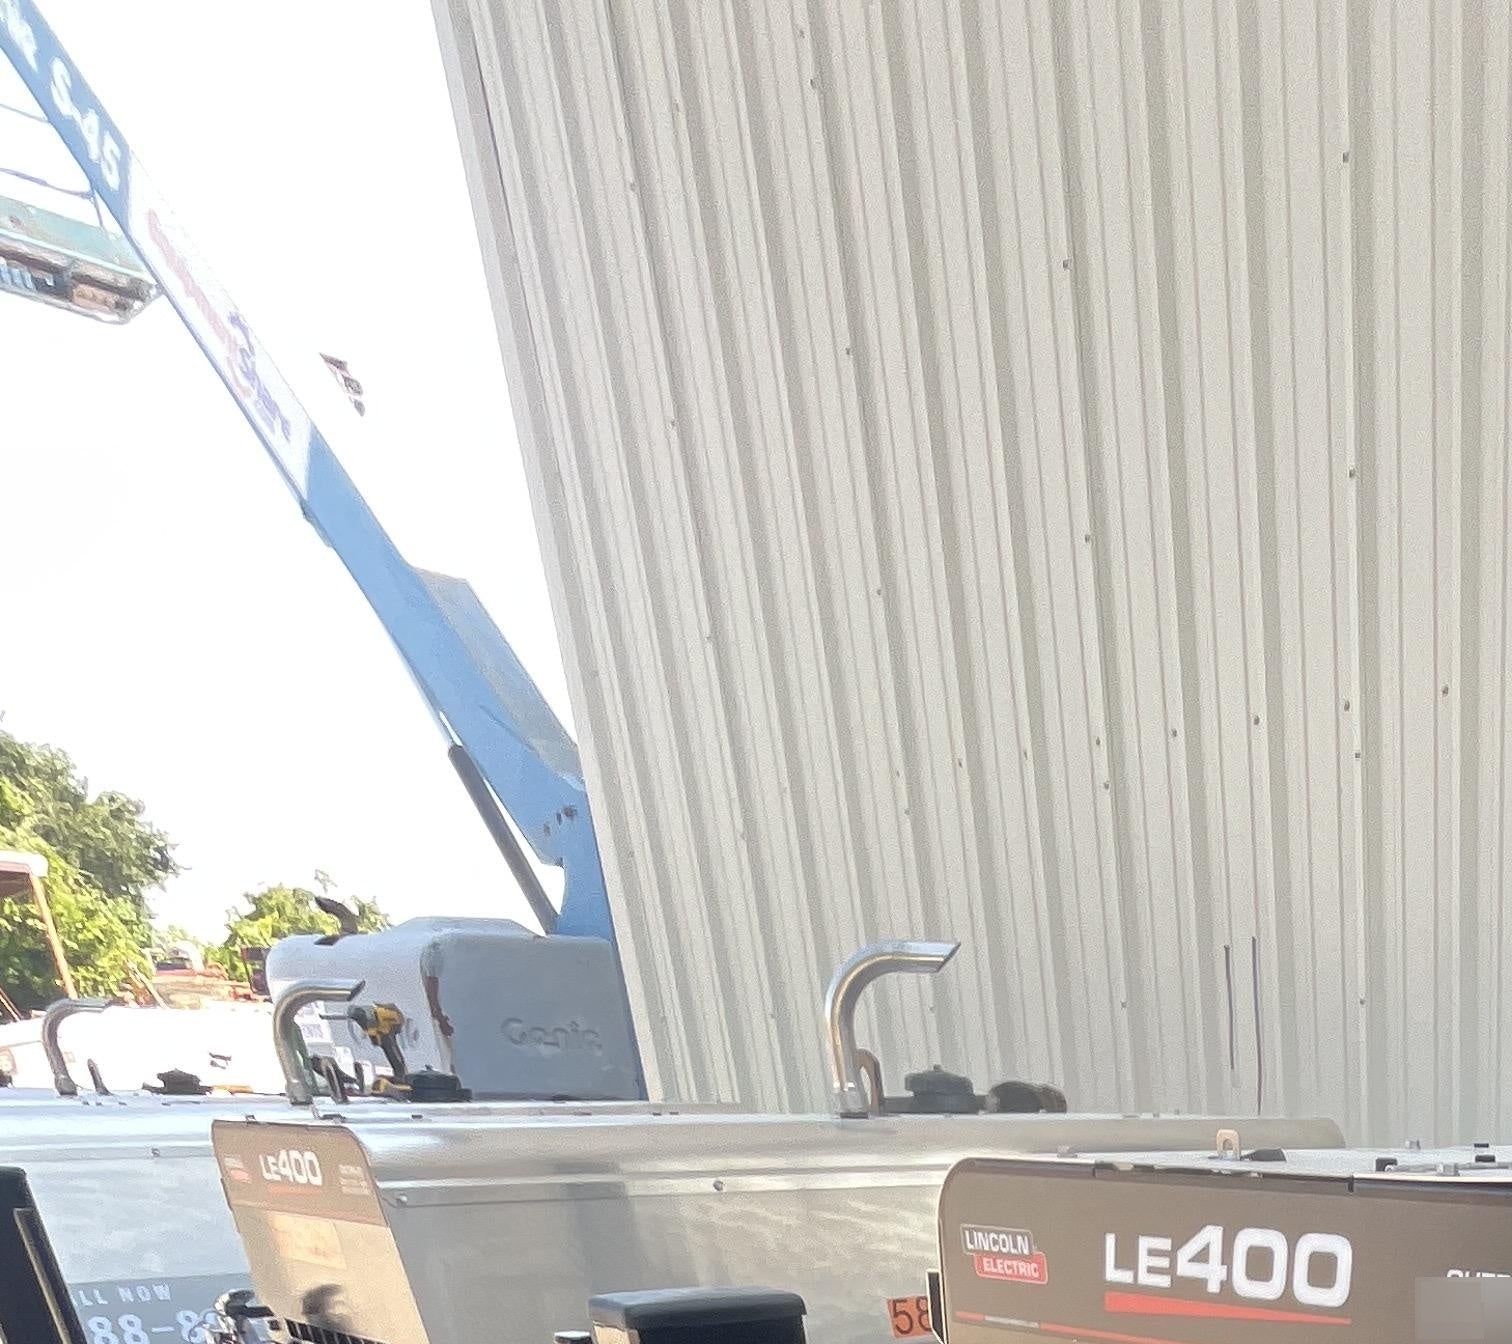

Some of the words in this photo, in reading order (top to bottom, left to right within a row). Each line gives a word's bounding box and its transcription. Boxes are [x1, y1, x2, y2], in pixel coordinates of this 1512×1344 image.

[259, 1150, 323, 1187] LE400
[964, 1230, 1030, 1255] LINCOLN
[982, 1257, 1040, 1278] ELECTRIC
[1105, 1225, 1352, 1307] LE400
[70, 1289, 109, 1306] LL
[117, 1281, 171, 1303] NOW
